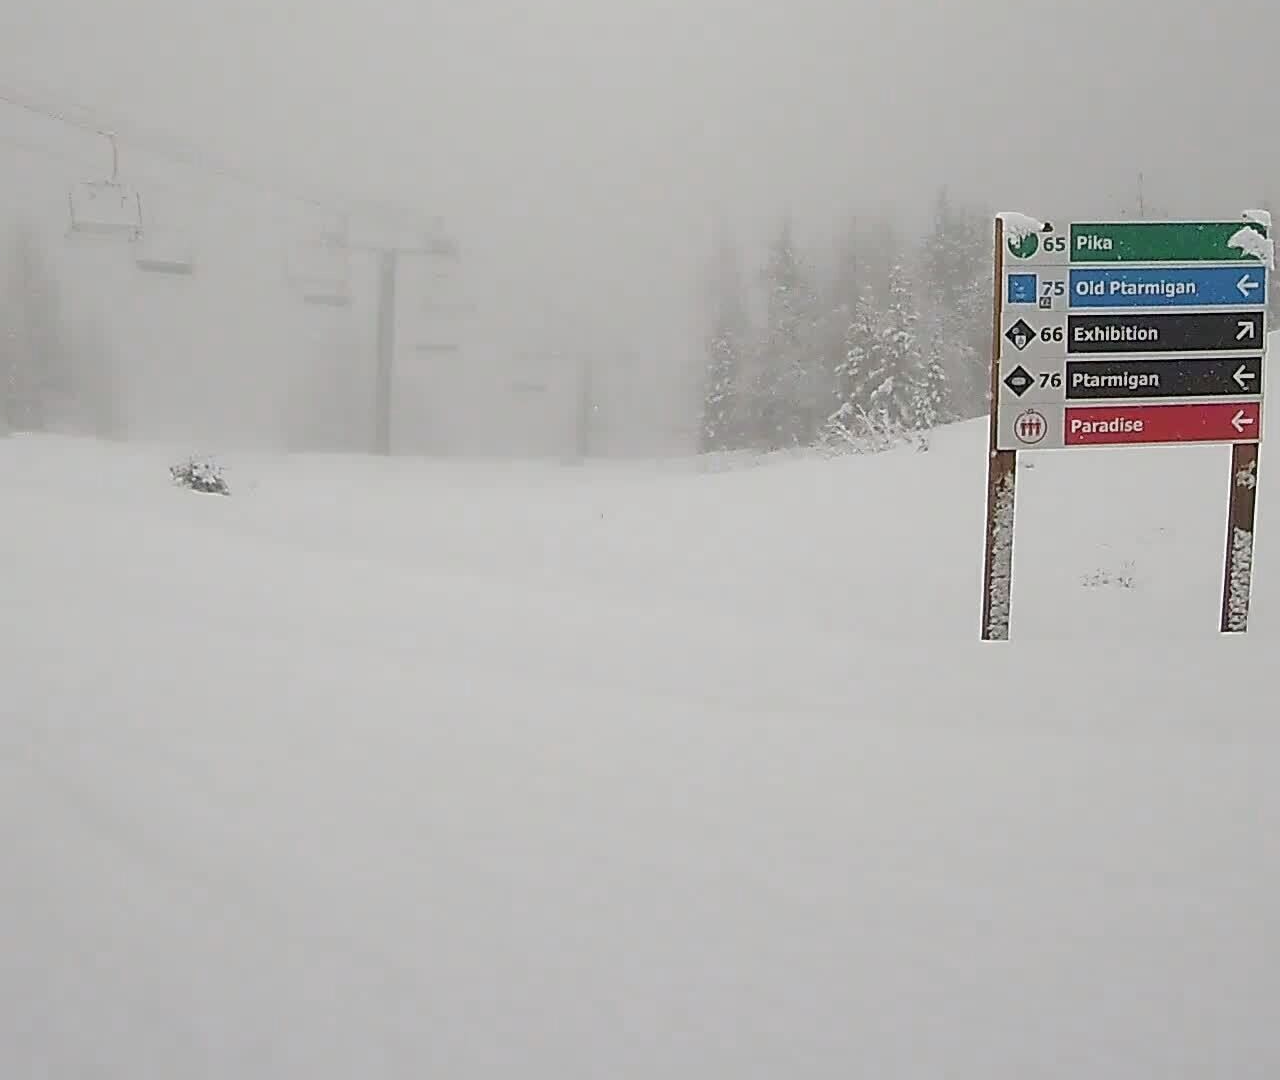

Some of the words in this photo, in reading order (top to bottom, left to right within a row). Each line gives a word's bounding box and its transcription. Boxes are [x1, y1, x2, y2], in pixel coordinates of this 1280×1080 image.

[1043, 237, 1066, 252] 65
[1076, 235, 1113, 250] Pika
[1042, 281, 1065, 296] 75
[1076, 280, 1105, 295] Old
[1109, 280, 1196, 298] Ptarmigan
[1040, 326, 1063, 342] 66
[1074, 324, 1158, 341] Exhibition
[1039, 373, 1062, 388] 76
[1072, 372, 1159, 390] Ptarmigan
[1071, 417, 1143, 434] Paradise
